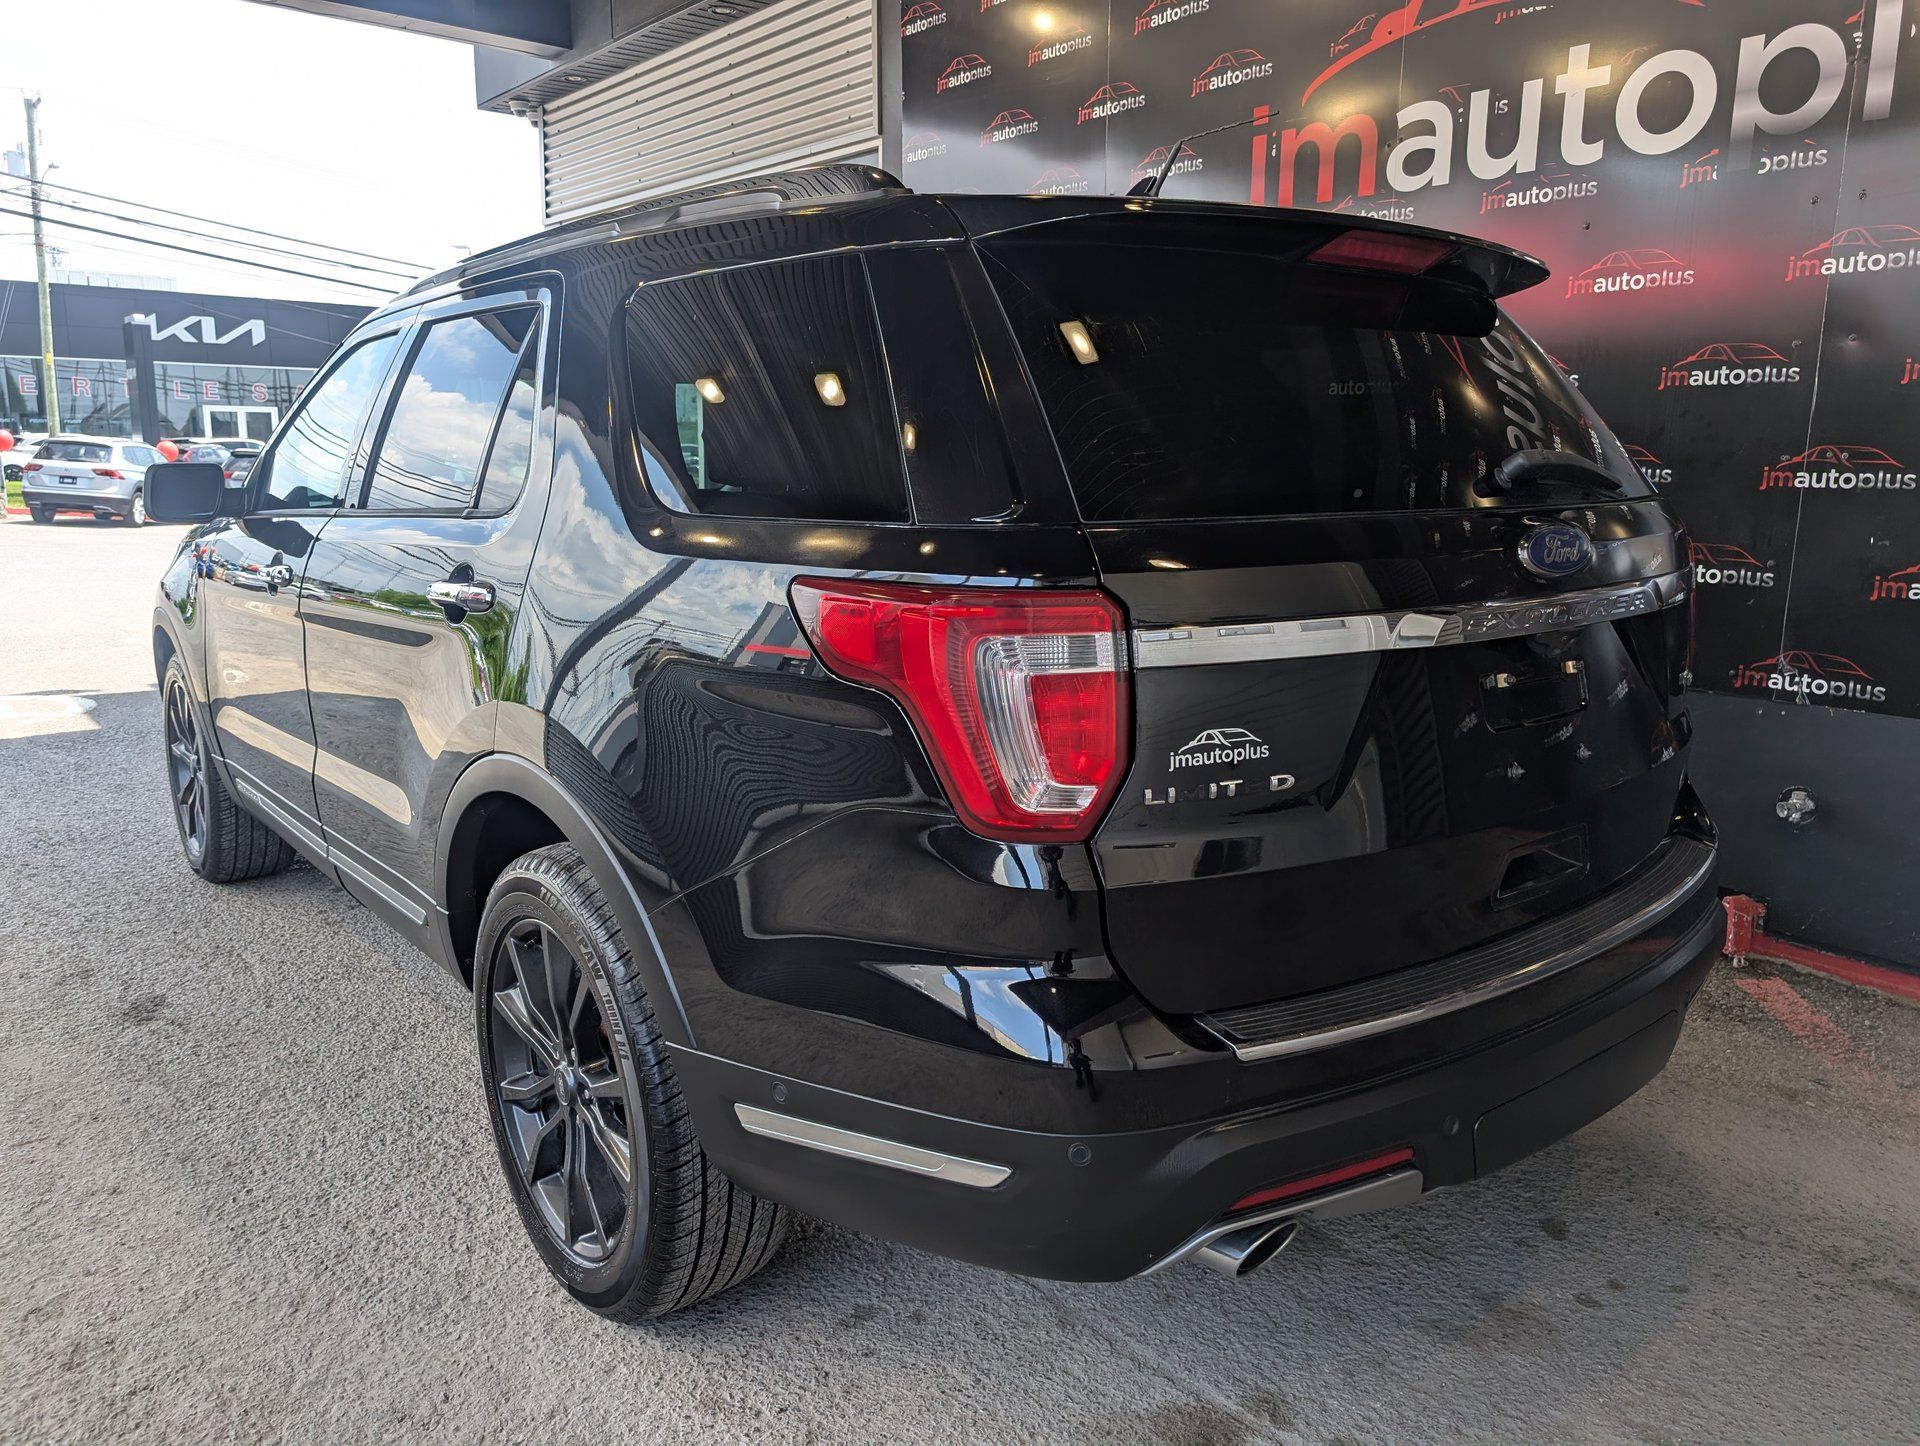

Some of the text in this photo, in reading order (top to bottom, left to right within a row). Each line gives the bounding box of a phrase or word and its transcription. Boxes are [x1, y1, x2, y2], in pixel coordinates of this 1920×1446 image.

[1134, 0, 1210, 36] jmautoplus
[1027, 29, 1092, 67] jmautoplus
[937, 65, 992, 95] jmautoplus
[1190, 62, 1273, 97] jmautoplus
[1077, 94, 1146, 125] jmautoplus
[980, 120, 1039, 148] jmautoplus
[1480, 180, 1598, 214] jmautoplus
[1565, 269, 1695, 298] jmautoplus
[146, 313, 266, 346] KIA
[1658, 365, 1800, 390] jmautoplus
[1760, 467, 1917, 490] jmautoplus
[1543, 533, 1581, 563] Ford
[1734, 665, 1886, 701] jmautoplus
[1169, 743, 1270, 772] jmautoplus
[1144, 774, 1296, 806] LIMITD
